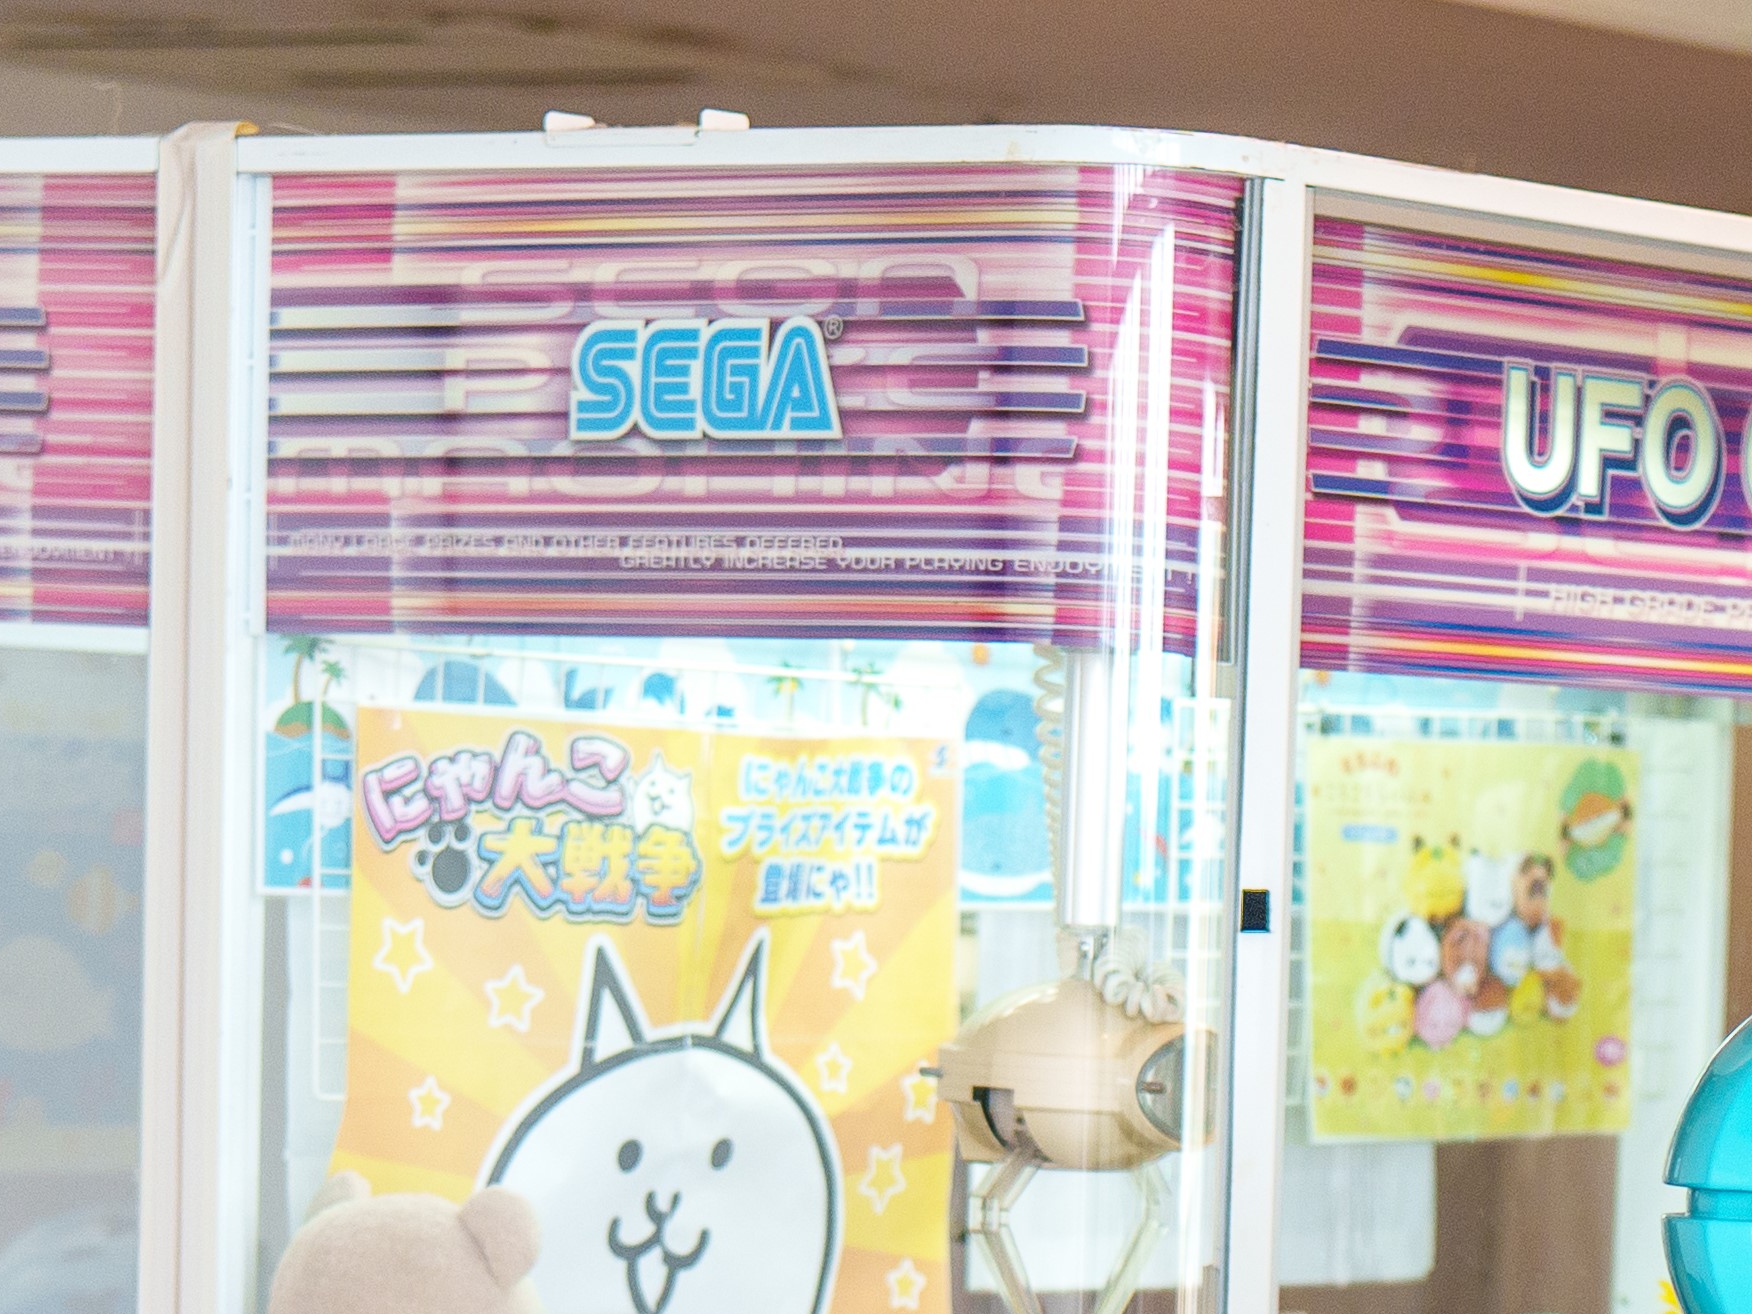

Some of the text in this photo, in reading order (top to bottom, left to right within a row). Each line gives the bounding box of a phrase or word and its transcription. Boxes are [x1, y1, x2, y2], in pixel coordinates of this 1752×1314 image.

[570, 316, 842, 441] SEGA
[1500, 357, 1726, 530] UFO
[620, 552, 715, 570] GREATLY
[724, 554, 827, 571] INCREASE
[837, 555, 896, 572] YOUR
[907, 556, 1004, 573] PLAYING
[362, 731, 630, 850] にゃんこ
[725, 808, 933, 850] プライズアイテムが
[474, 818, 702, 924] 大戦争
